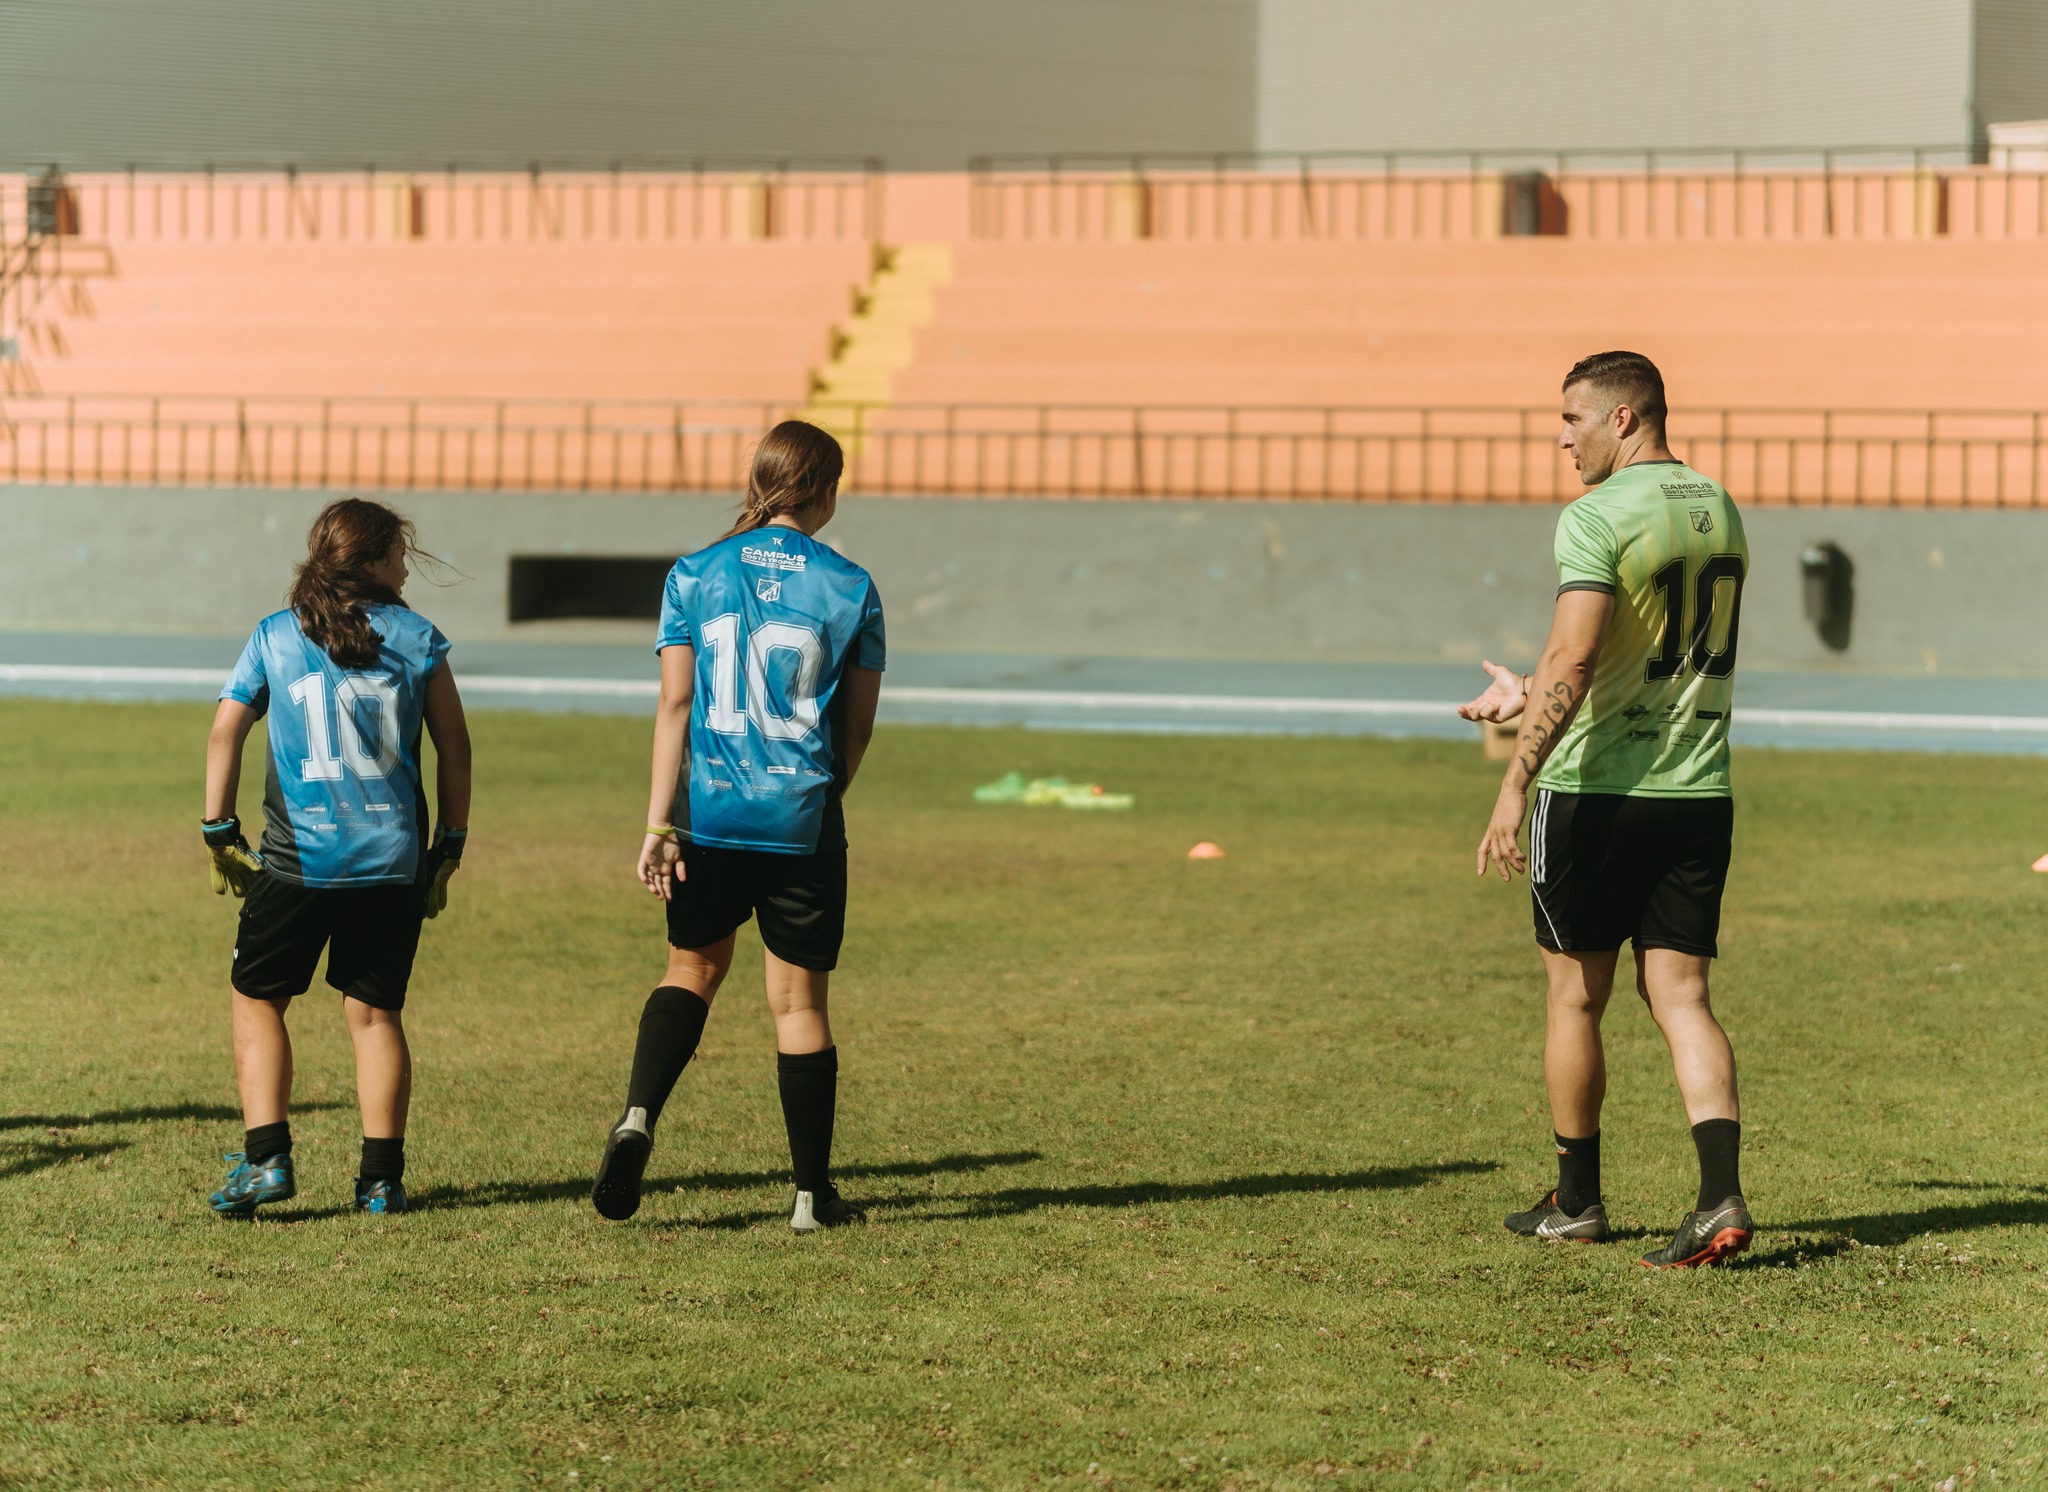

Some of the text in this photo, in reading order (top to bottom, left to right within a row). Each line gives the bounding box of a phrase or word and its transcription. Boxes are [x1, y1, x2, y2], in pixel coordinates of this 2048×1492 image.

[741, 553, 767, 563] COSTA
[768, 557, 806, 567] TROPICAL
[742, 546, 807, 562] CAMPUS
[1644, 553, 1745, 684] 10
[288, 671, 400, 782] 10
[701, 612, 825, 742] 10
